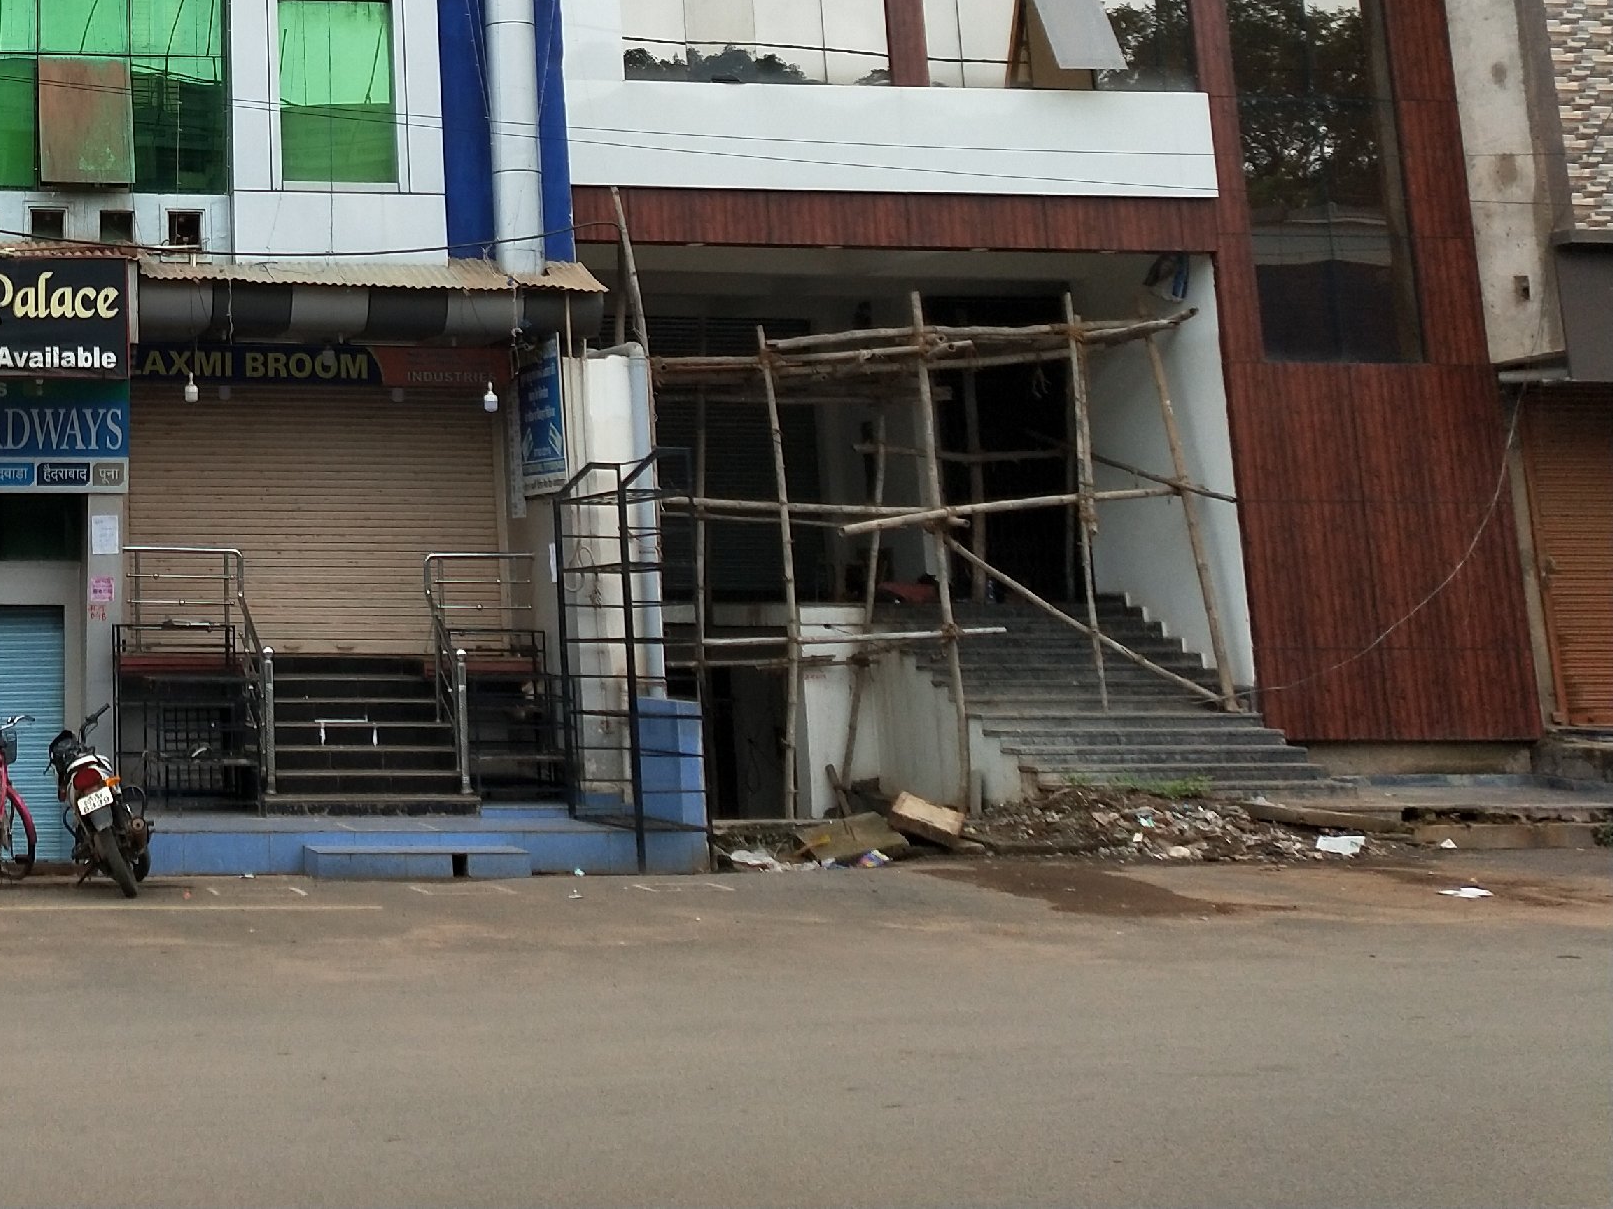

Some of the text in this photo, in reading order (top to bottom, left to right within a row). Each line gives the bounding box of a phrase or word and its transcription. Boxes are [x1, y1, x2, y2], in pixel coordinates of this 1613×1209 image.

[245, 352, 369, 379] BROOM
[407, 371, 497, 383] INDUSTRIES
[43, 464, 87, 482] हैदराबाद
[98, 468, 119, 484] पूना
